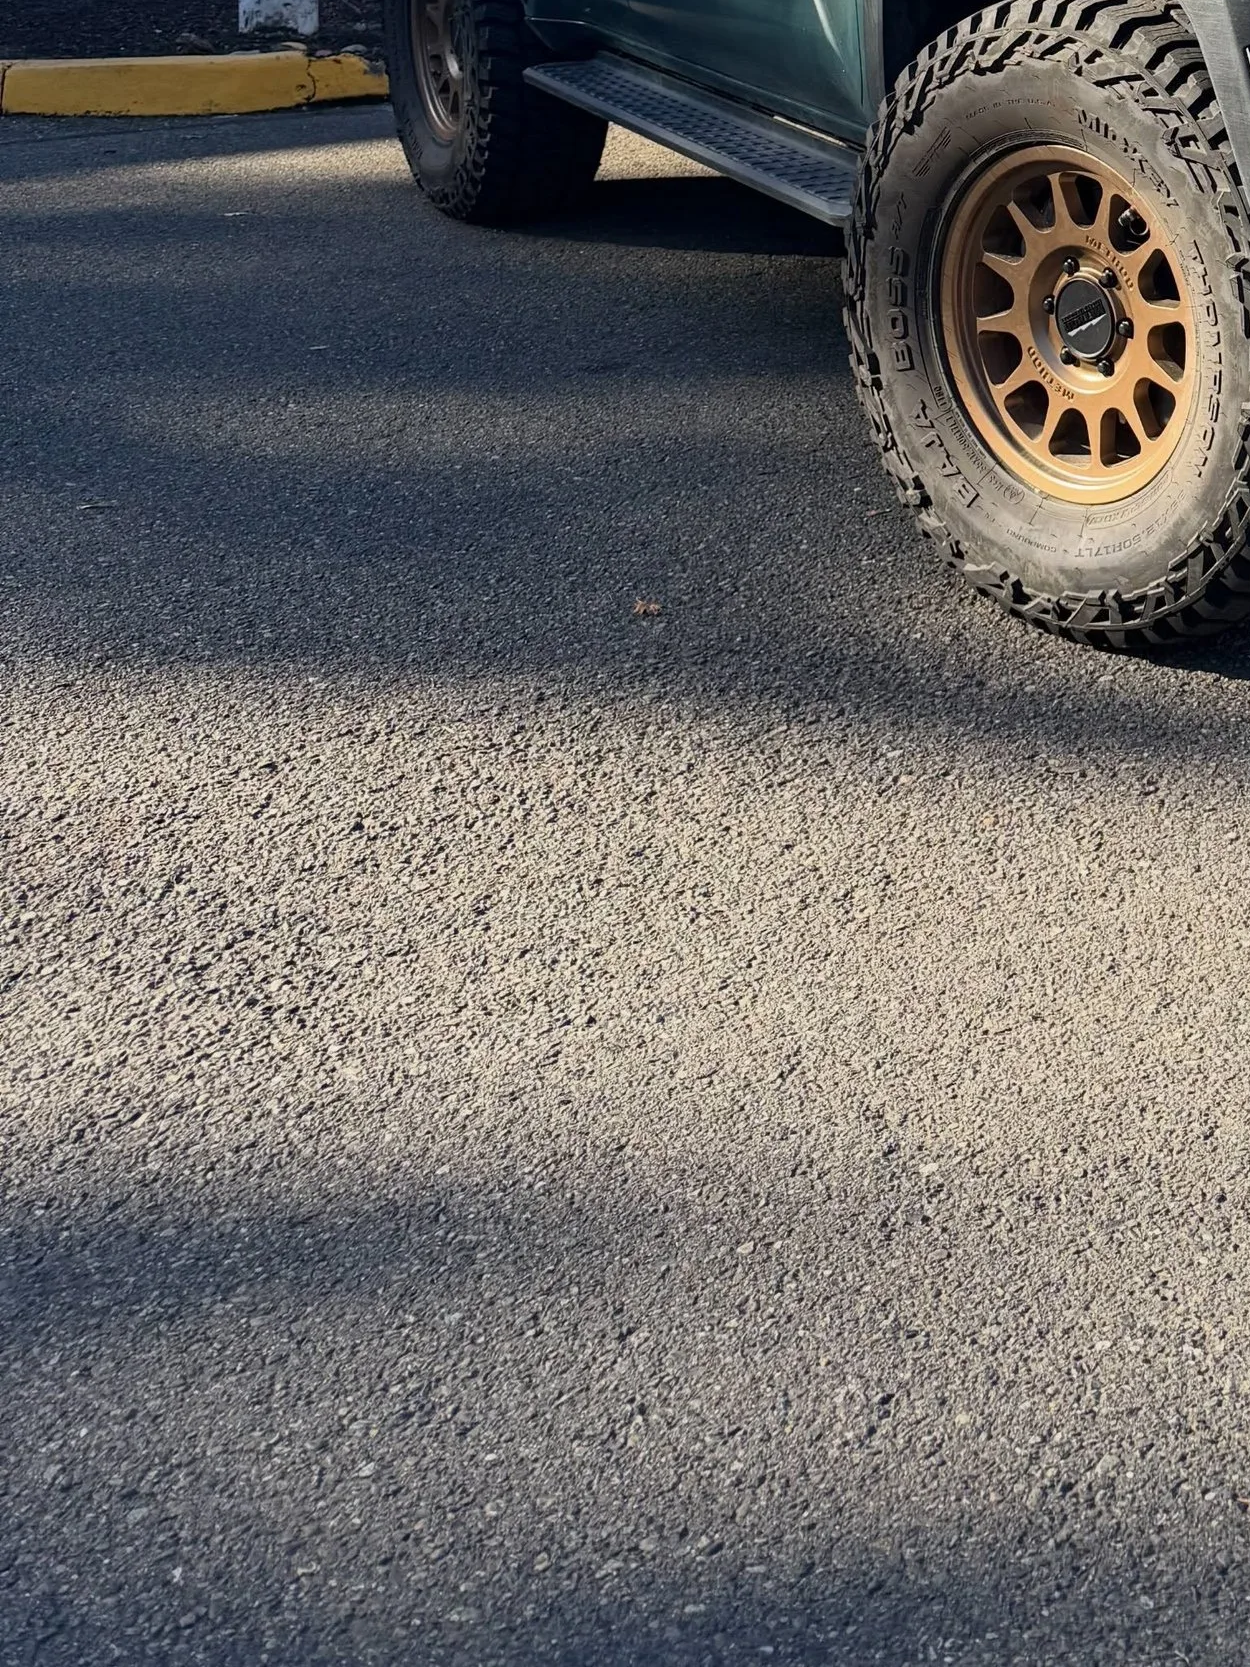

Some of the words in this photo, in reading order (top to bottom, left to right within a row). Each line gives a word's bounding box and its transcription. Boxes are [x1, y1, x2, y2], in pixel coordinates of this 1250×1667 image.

[888, 244, 915, 372] BOSS
[1189, 238, 1223, 479] THOMPSON
[1027, 345, 1075, 401] METHOD
[909, 398, 980, 509] BAJA
